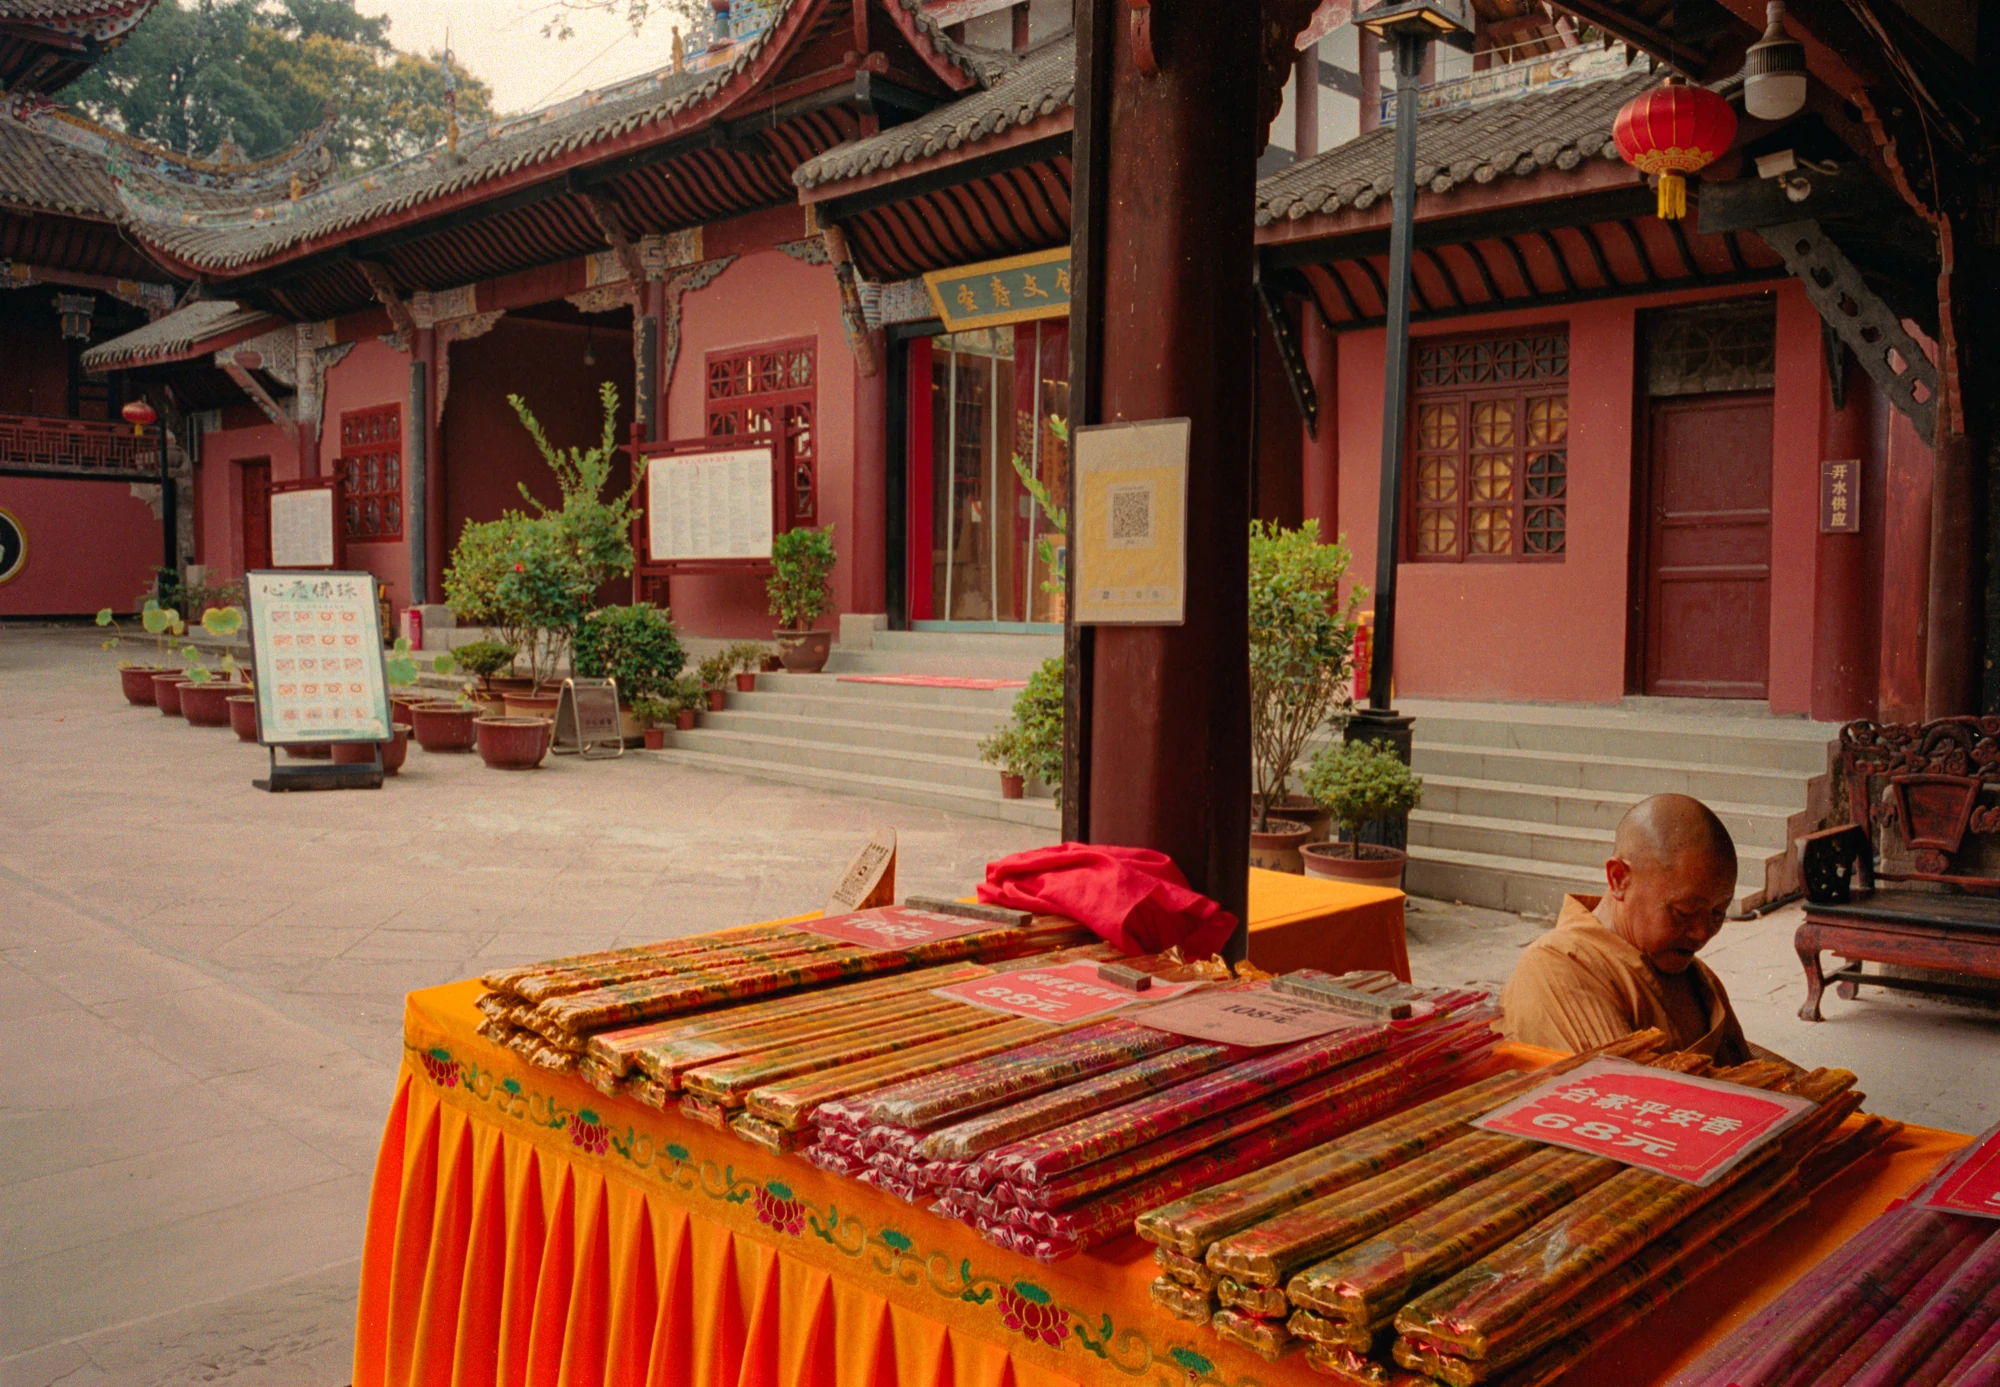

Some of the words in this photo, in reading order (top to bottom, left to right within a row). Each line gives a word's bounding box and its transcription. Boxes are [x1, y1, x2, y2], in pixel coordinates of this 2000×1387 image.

[1831, 464, 1848, 526] 开水供应
[975, 986, 1071, 1012] 88元
[1532, 1112, 1679, 1158] 68元
[1557, 1087, 1743, 1136] 合家平安香
